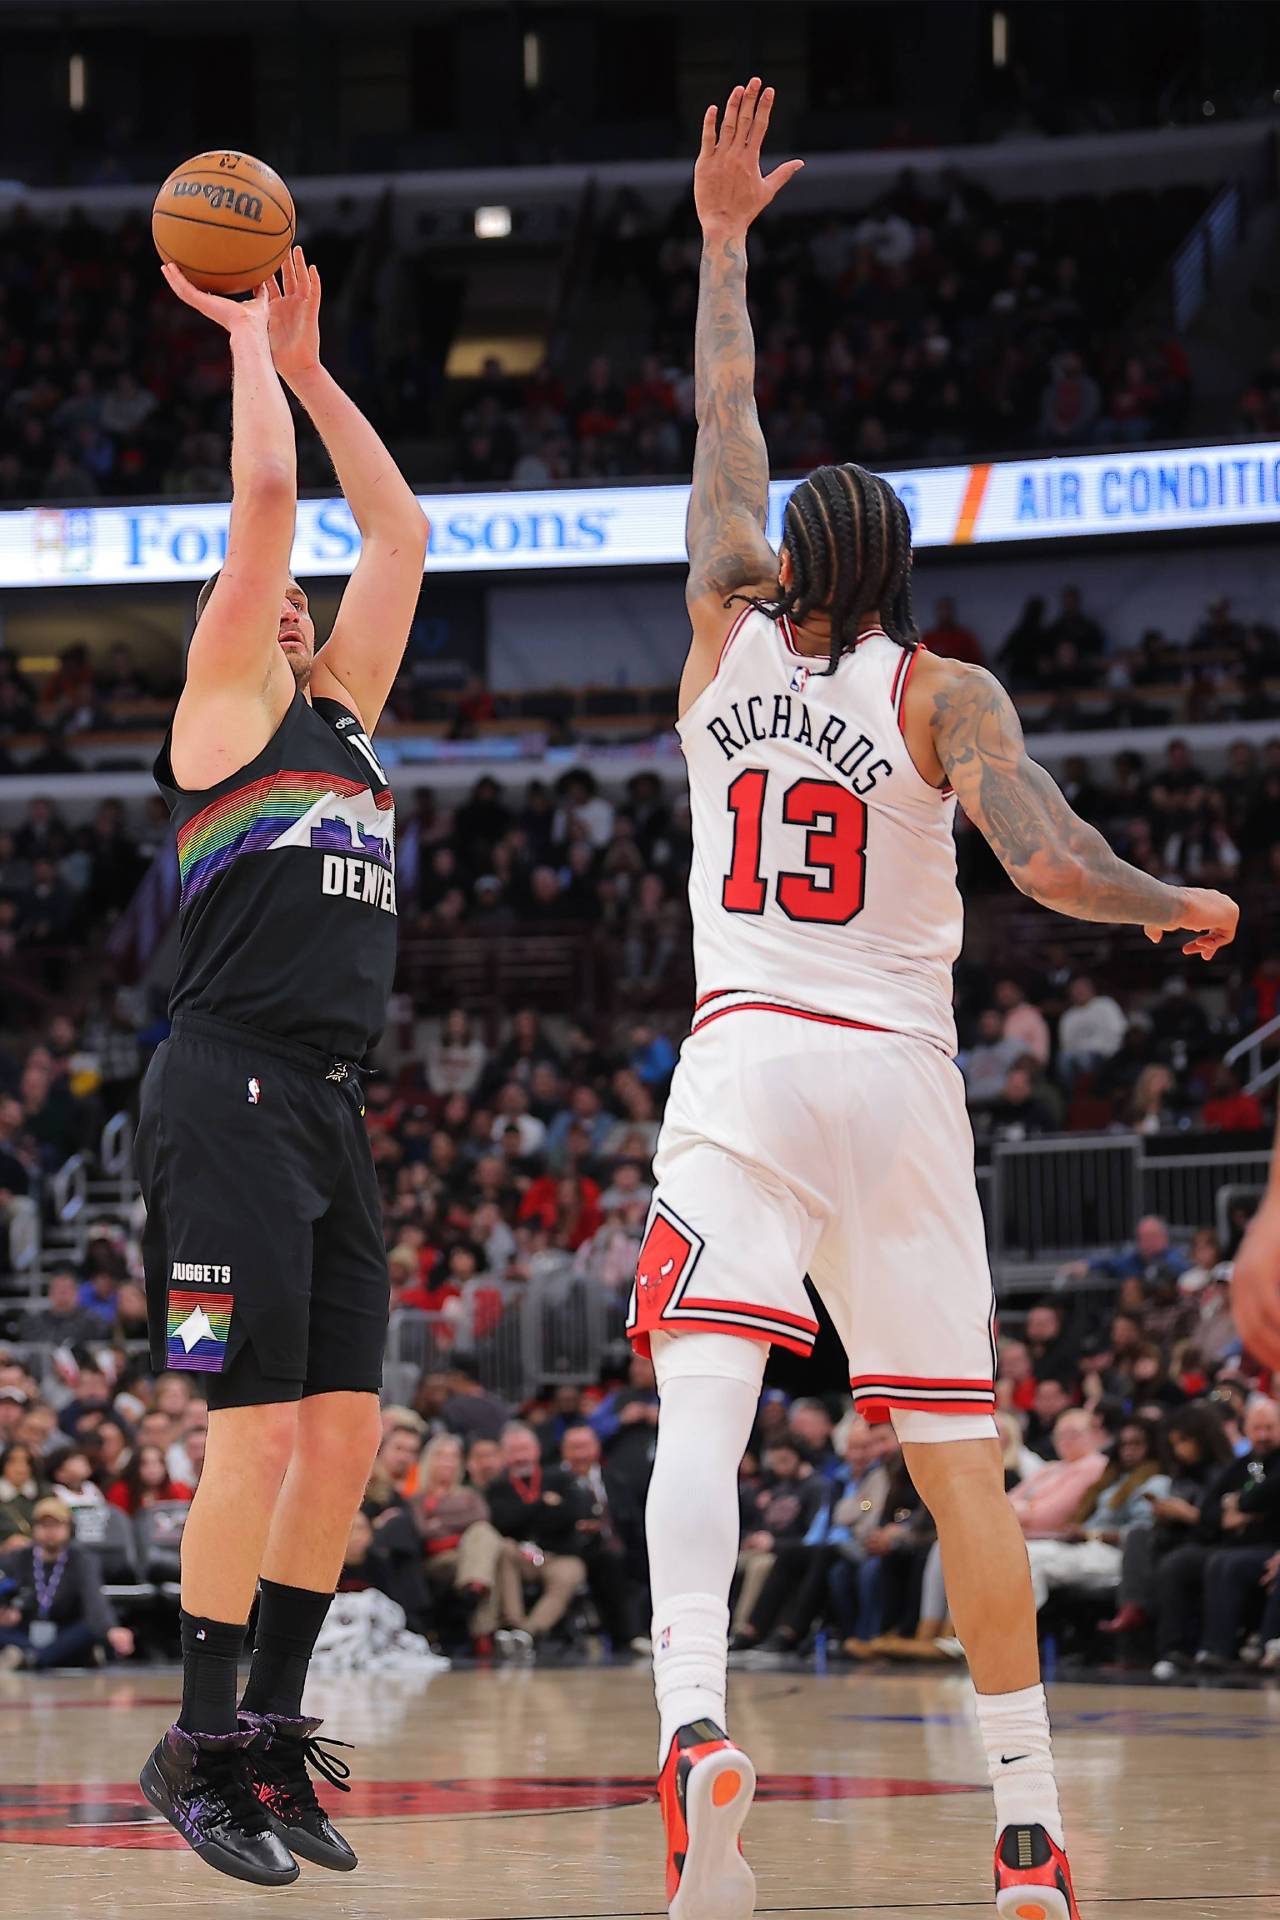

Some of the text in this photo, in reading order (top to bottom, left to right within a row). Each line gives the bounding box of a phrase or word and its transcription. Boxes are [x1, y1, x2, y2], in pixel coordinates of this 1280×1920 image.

[174, 182, 263, 222] Wilson
[1018, 471, 1082, 519] AIR
[123, 498, 606, 566] Fo Ssons
[707, 695, 893, 795] RICHARDS
[722, 768, 867, 926] 13
[171, 1262, 232, 1284] NUGGETS
